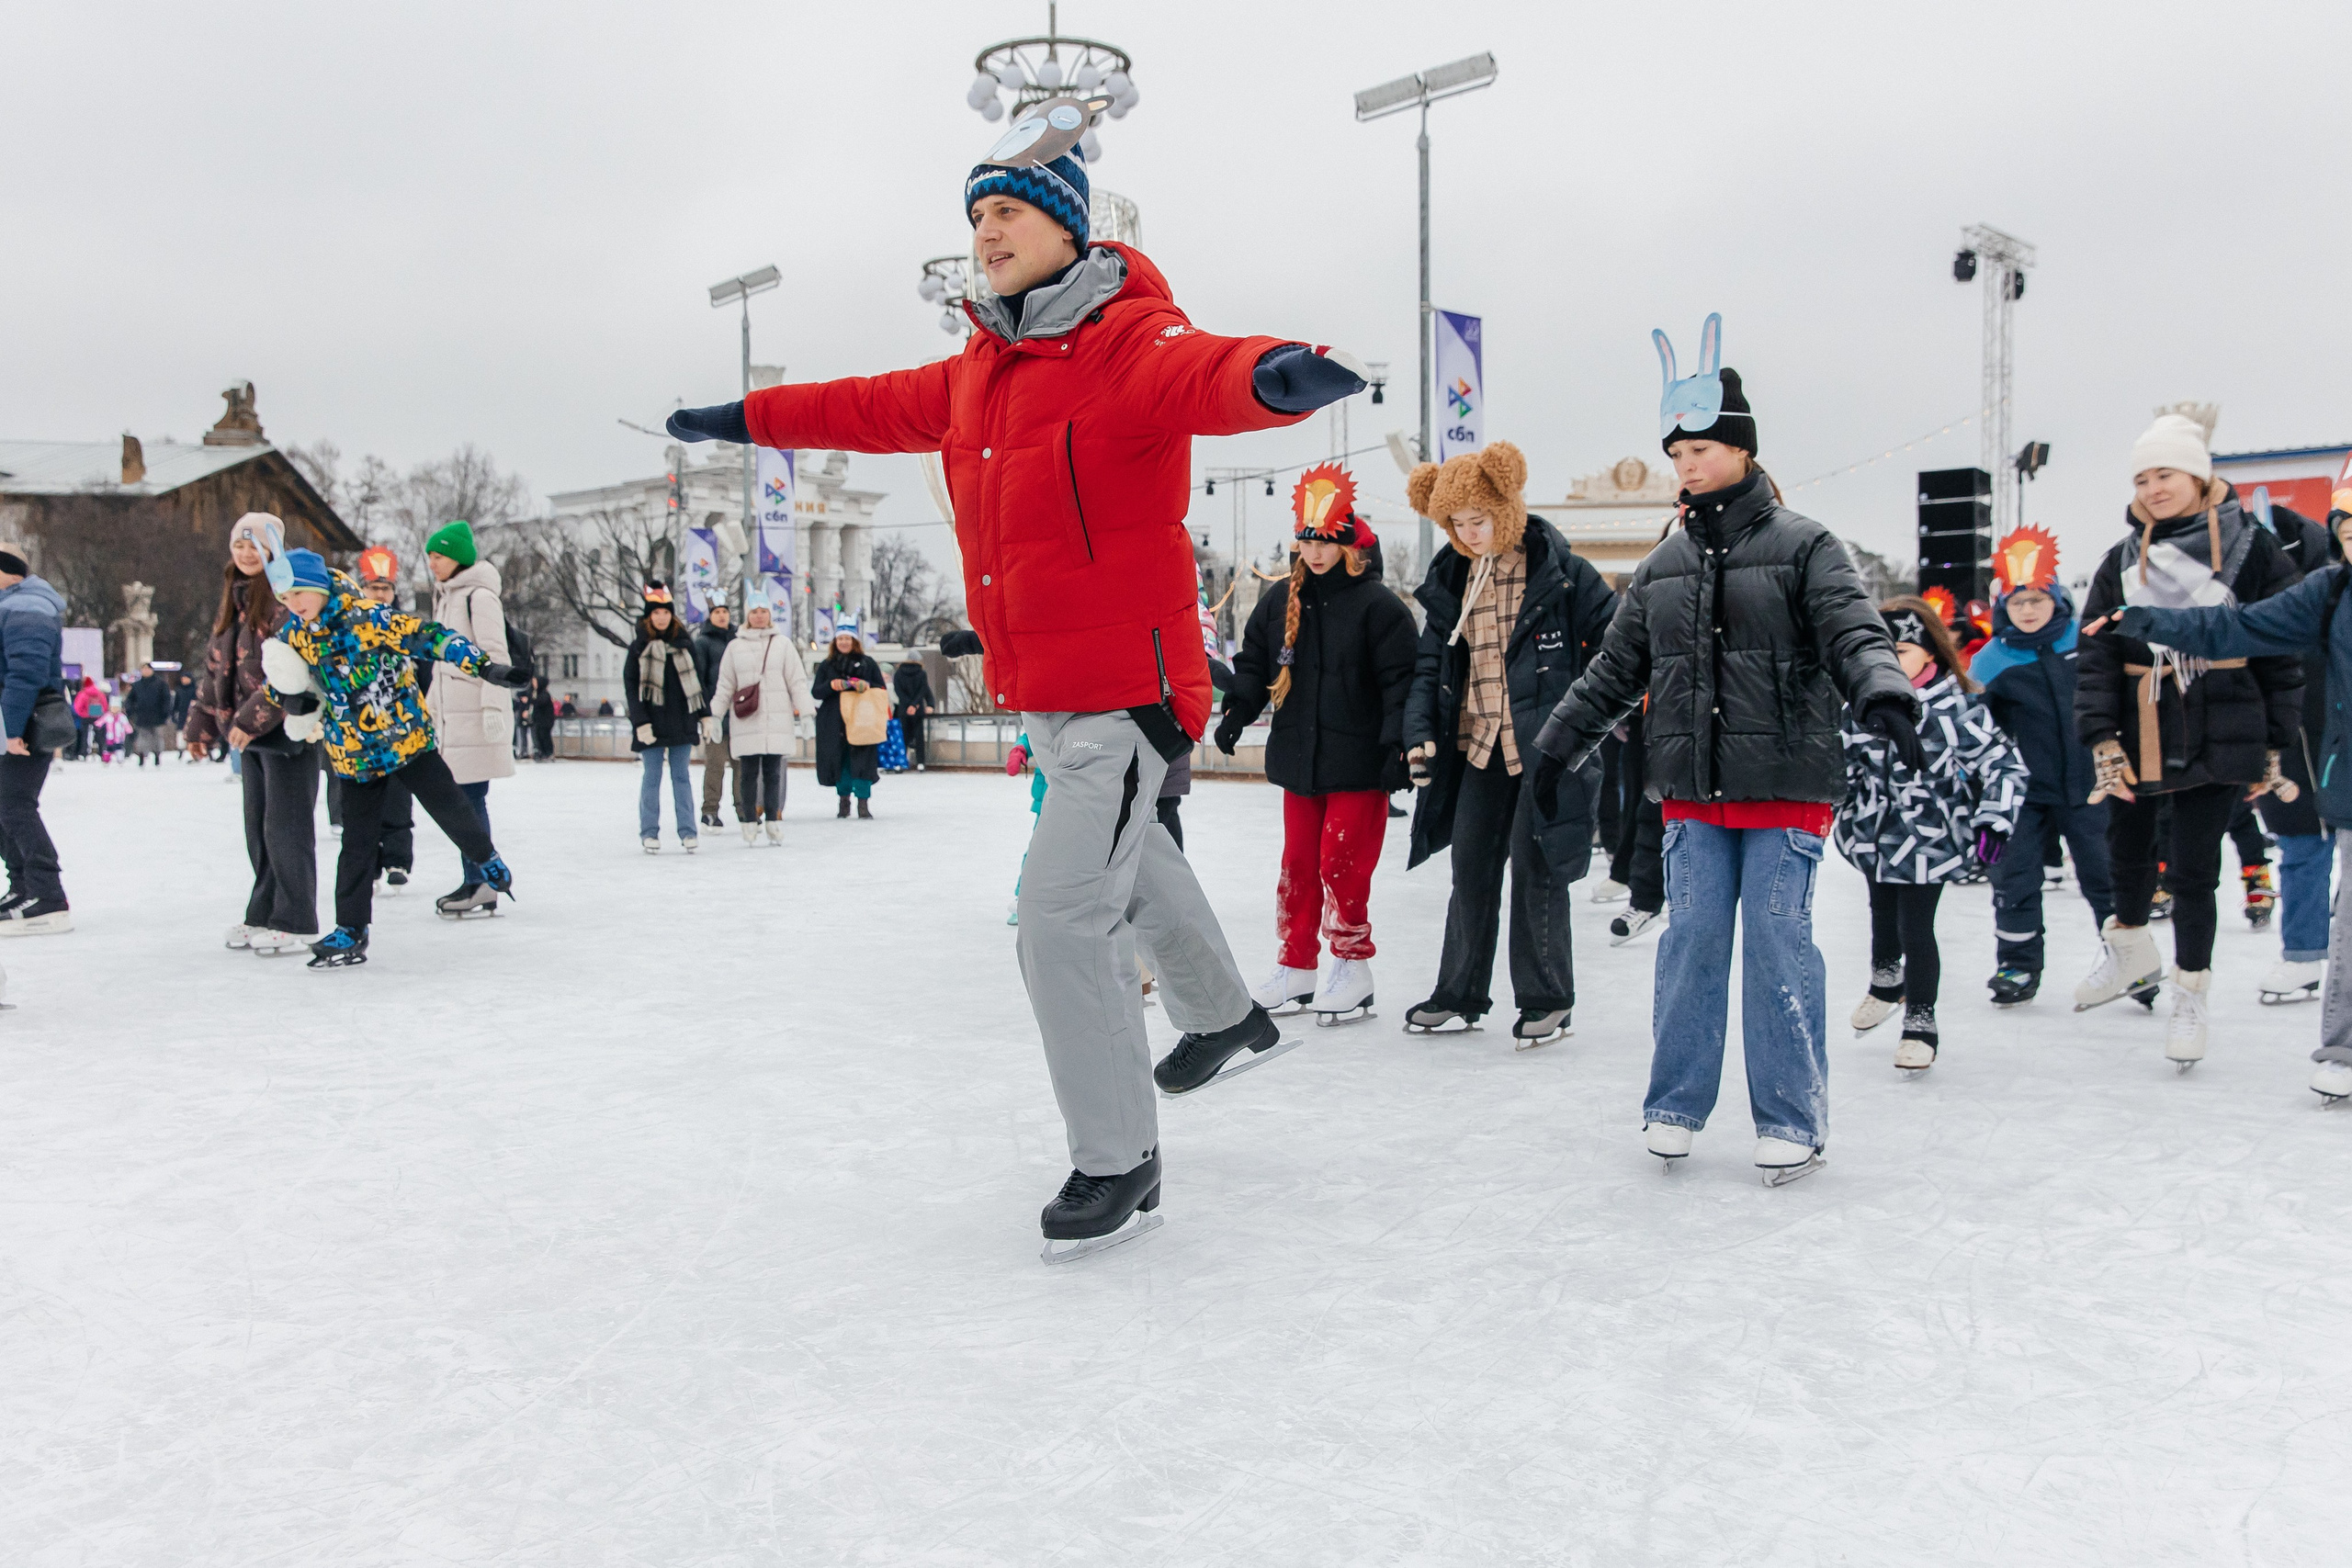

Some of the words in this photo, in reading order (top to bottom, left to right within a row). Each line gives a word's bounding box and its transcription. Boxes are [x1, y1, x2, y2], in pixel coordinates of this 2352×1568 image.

[1447, 426, 1475, 443] сбп
[764, 510, 788, 523] сбп
[1071, 740, 1103, 750] ZASPORT
